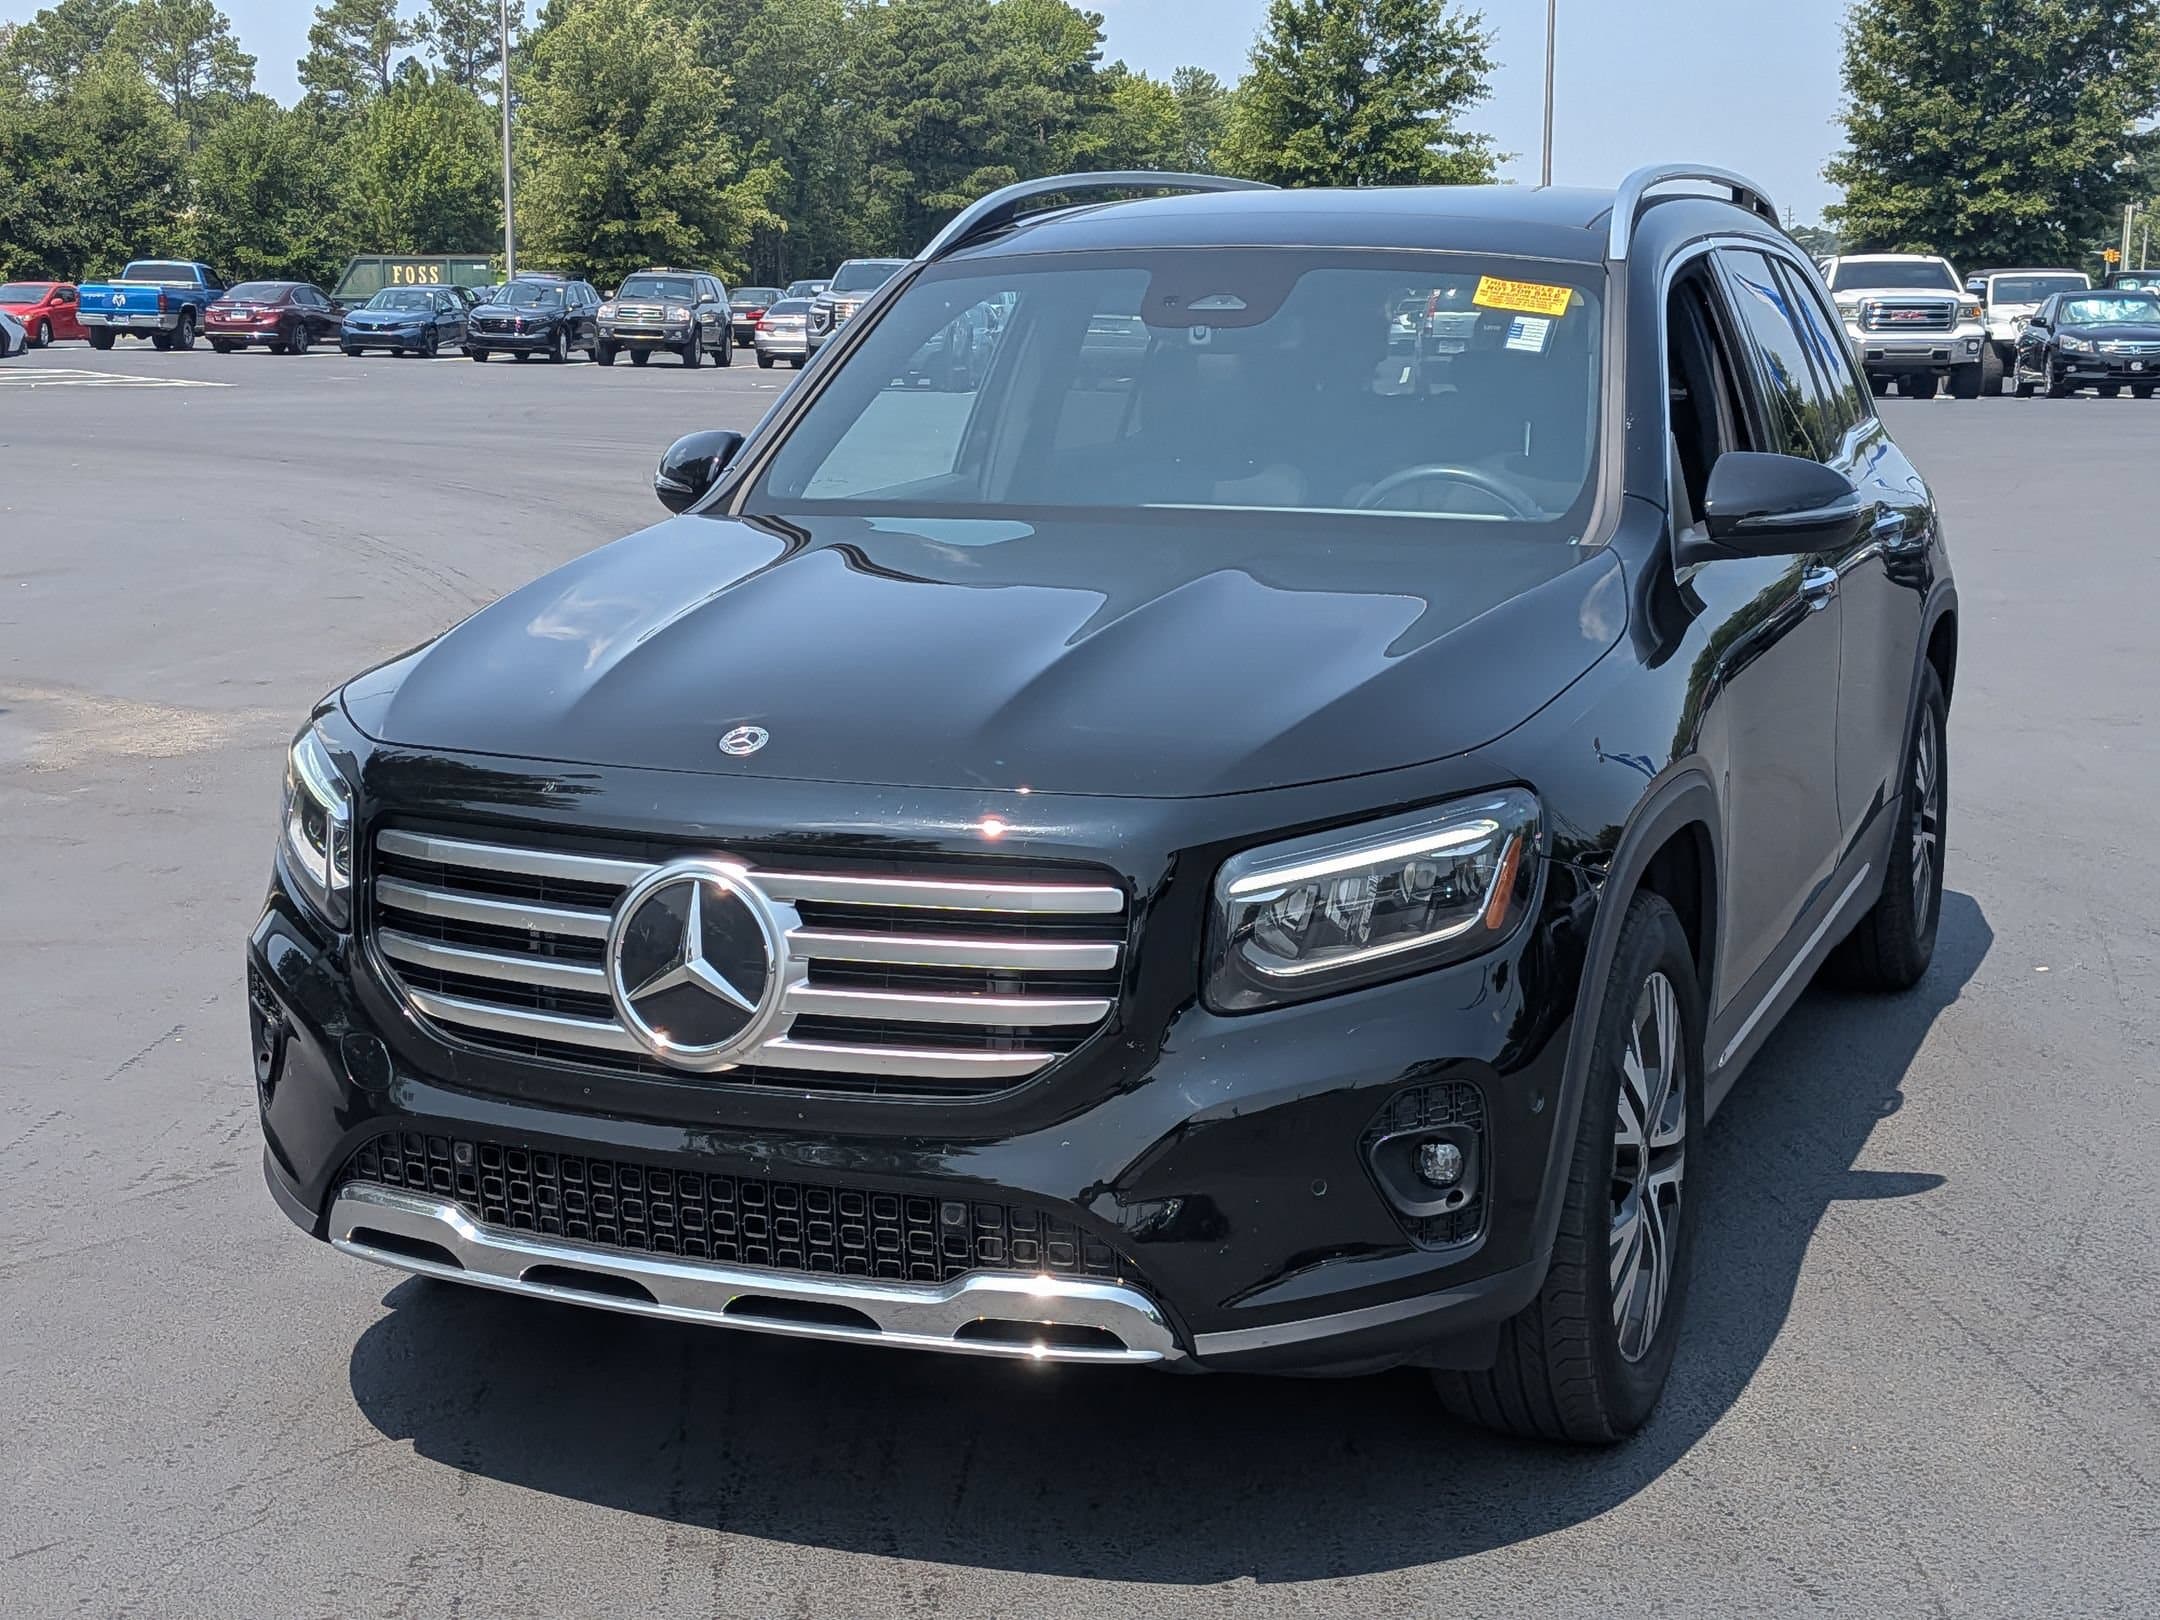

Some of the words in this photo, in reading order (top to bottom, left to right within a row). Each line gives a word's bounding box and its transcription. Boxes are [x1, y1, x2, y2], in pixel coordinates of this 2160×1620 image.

[392, 265, 439, 284] FOSS
[1485, 279, 1507, 287] THIS
[1510, 283, 1554, 292] VEHICLE
[1534, 290, 1560, 298] SALE
